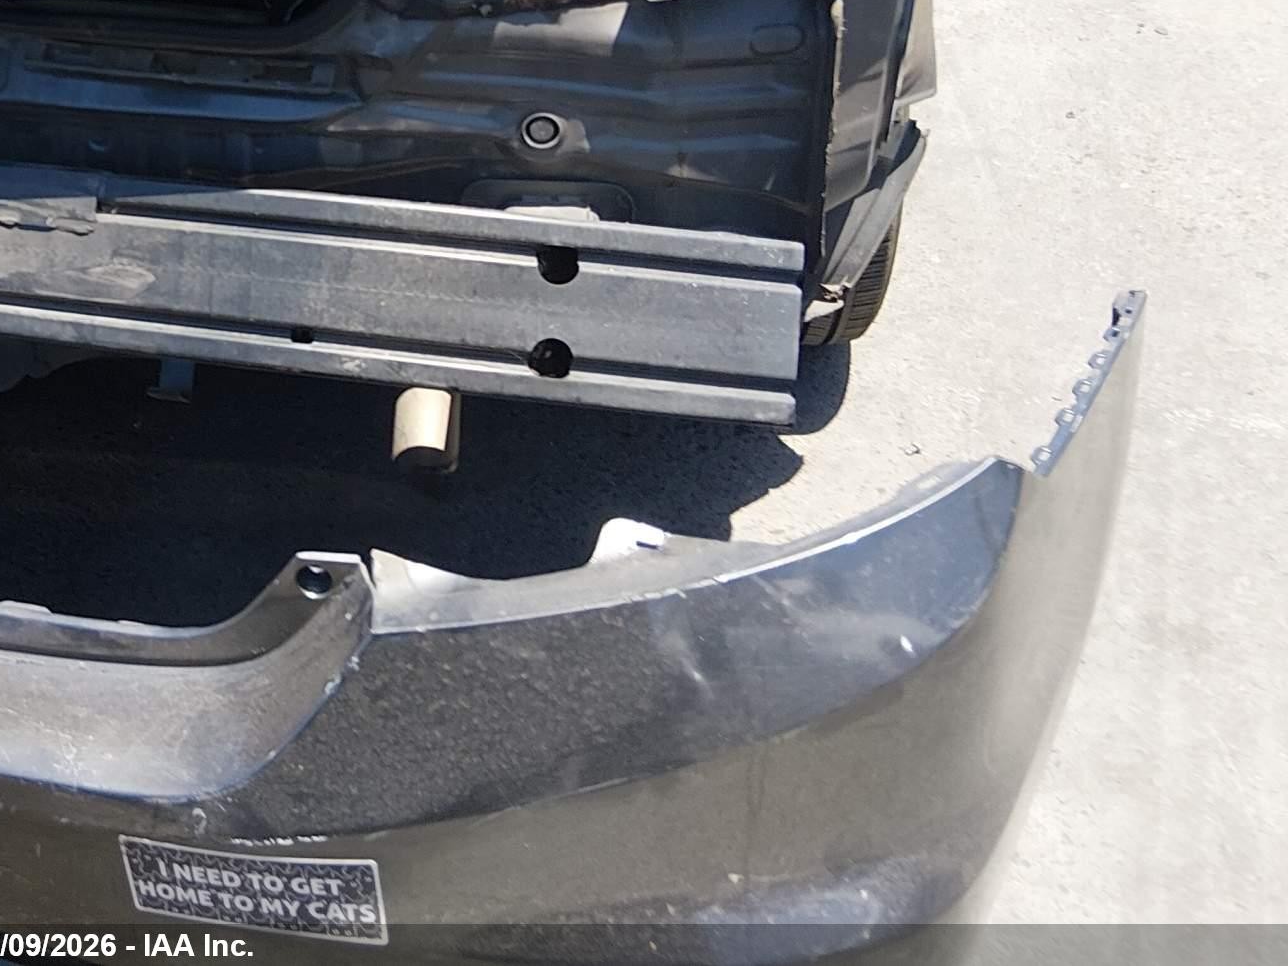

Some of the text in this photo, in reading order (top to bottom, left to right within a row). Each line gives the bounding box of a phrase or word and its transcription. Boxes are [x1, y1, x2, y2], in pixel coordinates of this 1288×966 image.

[157, 857, 343, 896] I NEED TO GET
[138, 878, 377, 924] HOME TO MY CATS
